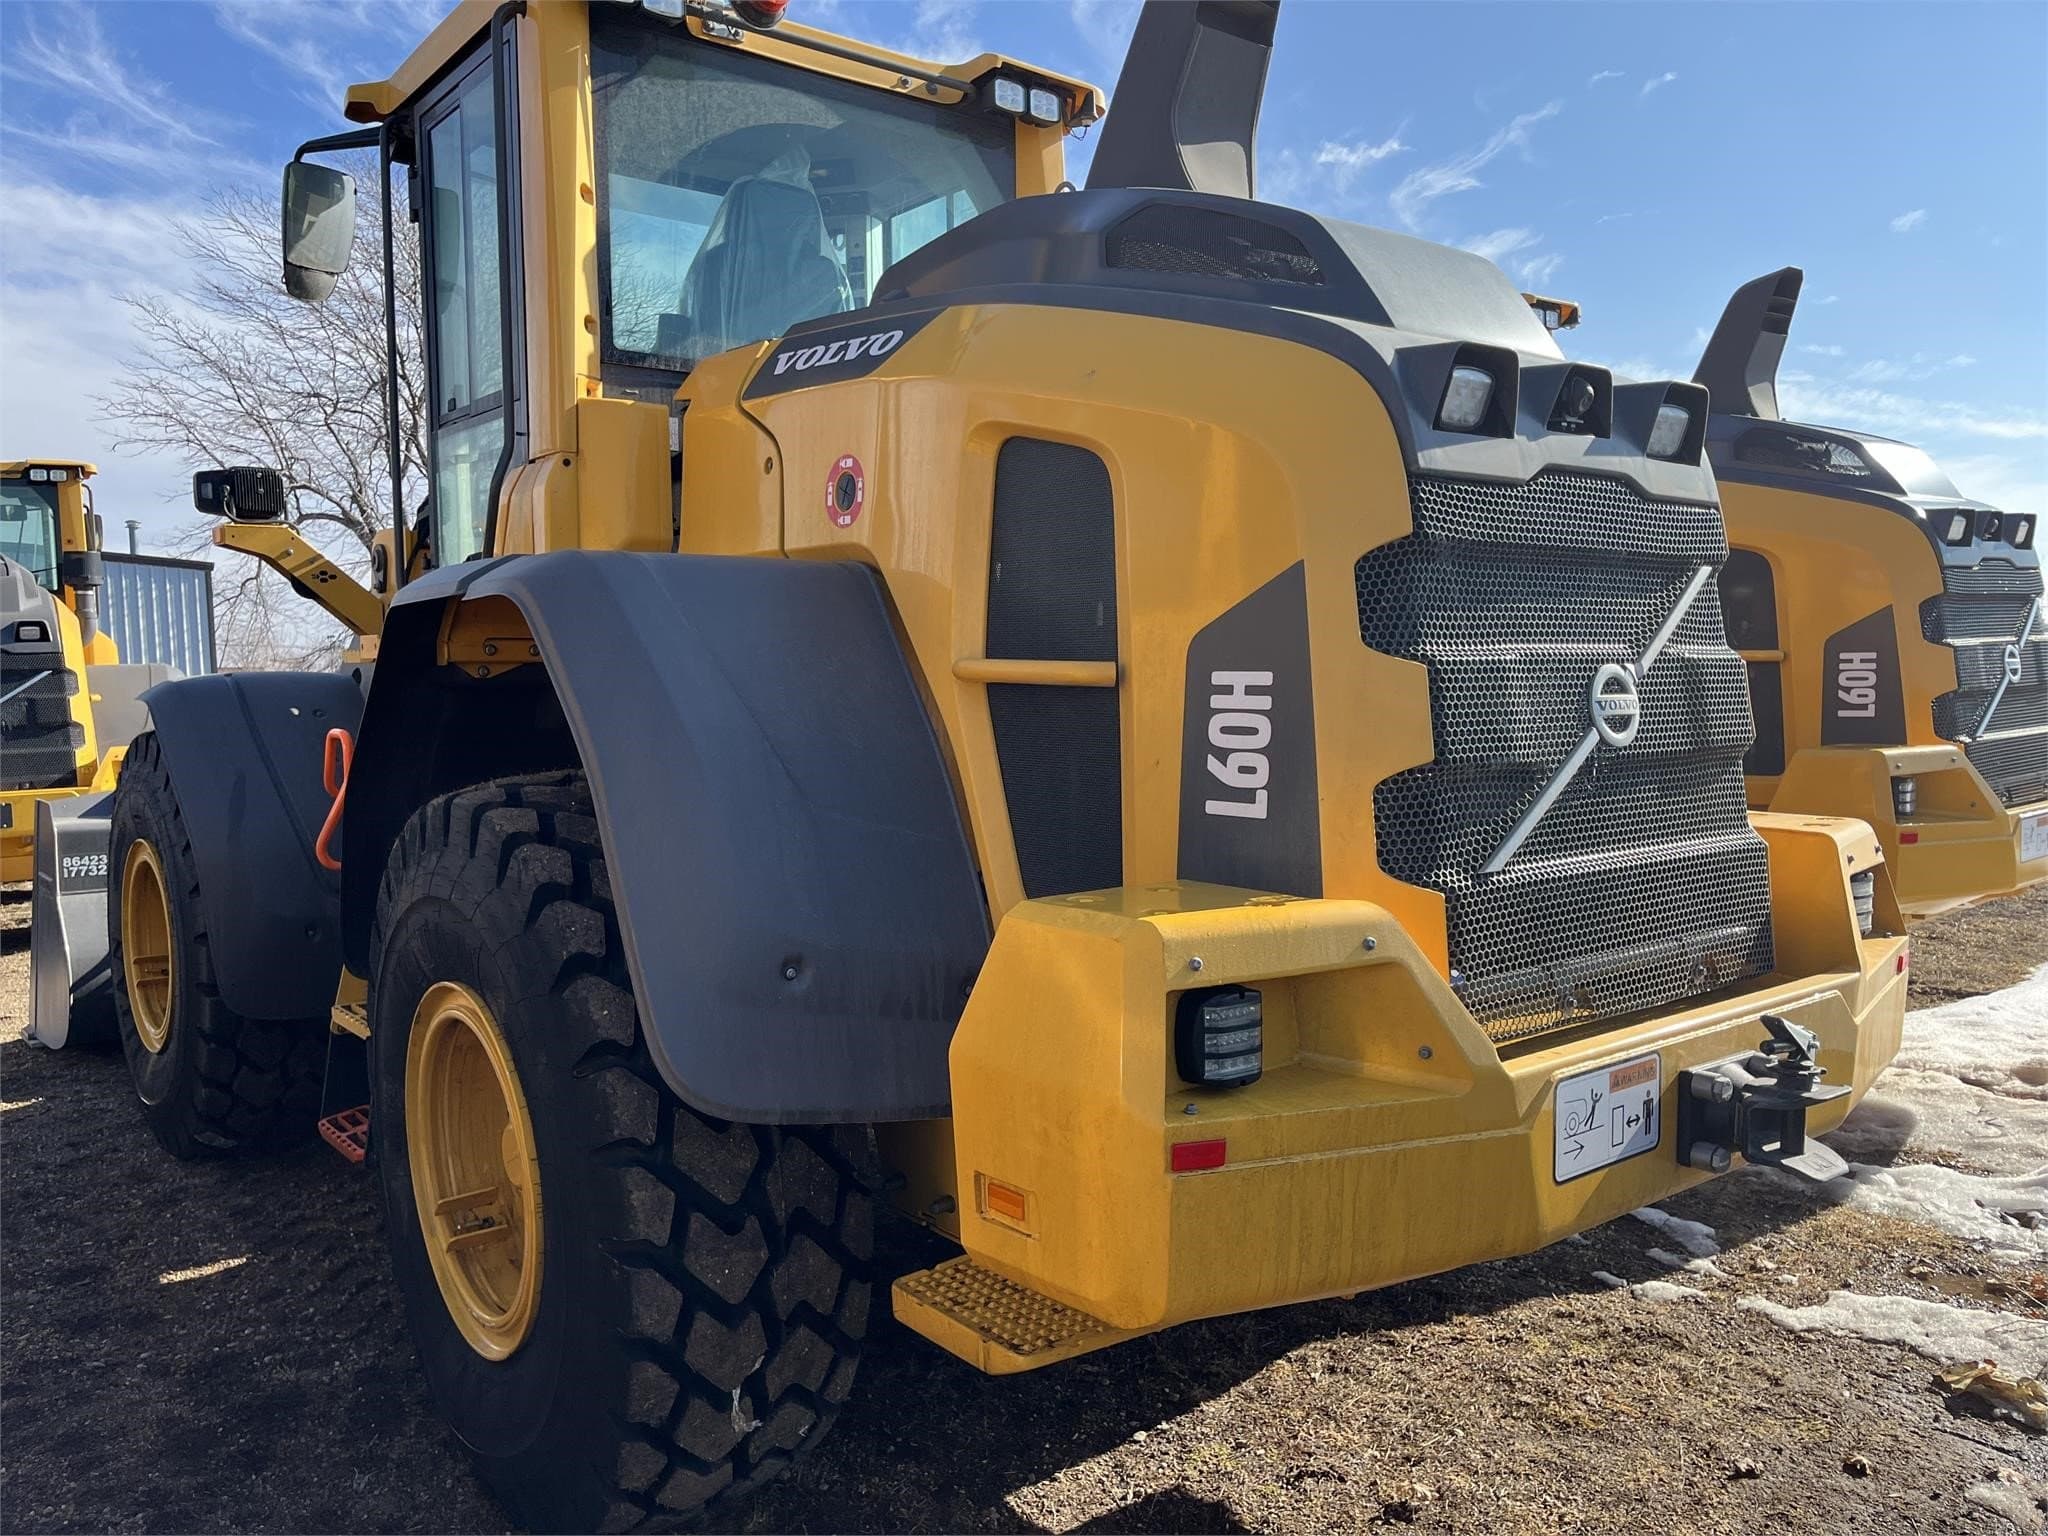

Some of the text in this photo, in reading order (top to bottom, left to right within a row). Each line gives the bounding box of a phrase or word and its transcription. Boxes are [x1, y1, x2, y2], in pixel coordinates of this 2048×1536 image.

[772, 330, 904, 376] VOLVO
[1838, 652, 1877, 717] L60H
[1595, 699, 1638, 711] VOLVO
[1205, 671, 1274, 819] L60H
[63, 854, 108, 867] 86423
[63, 864, 108, 878] 17732
